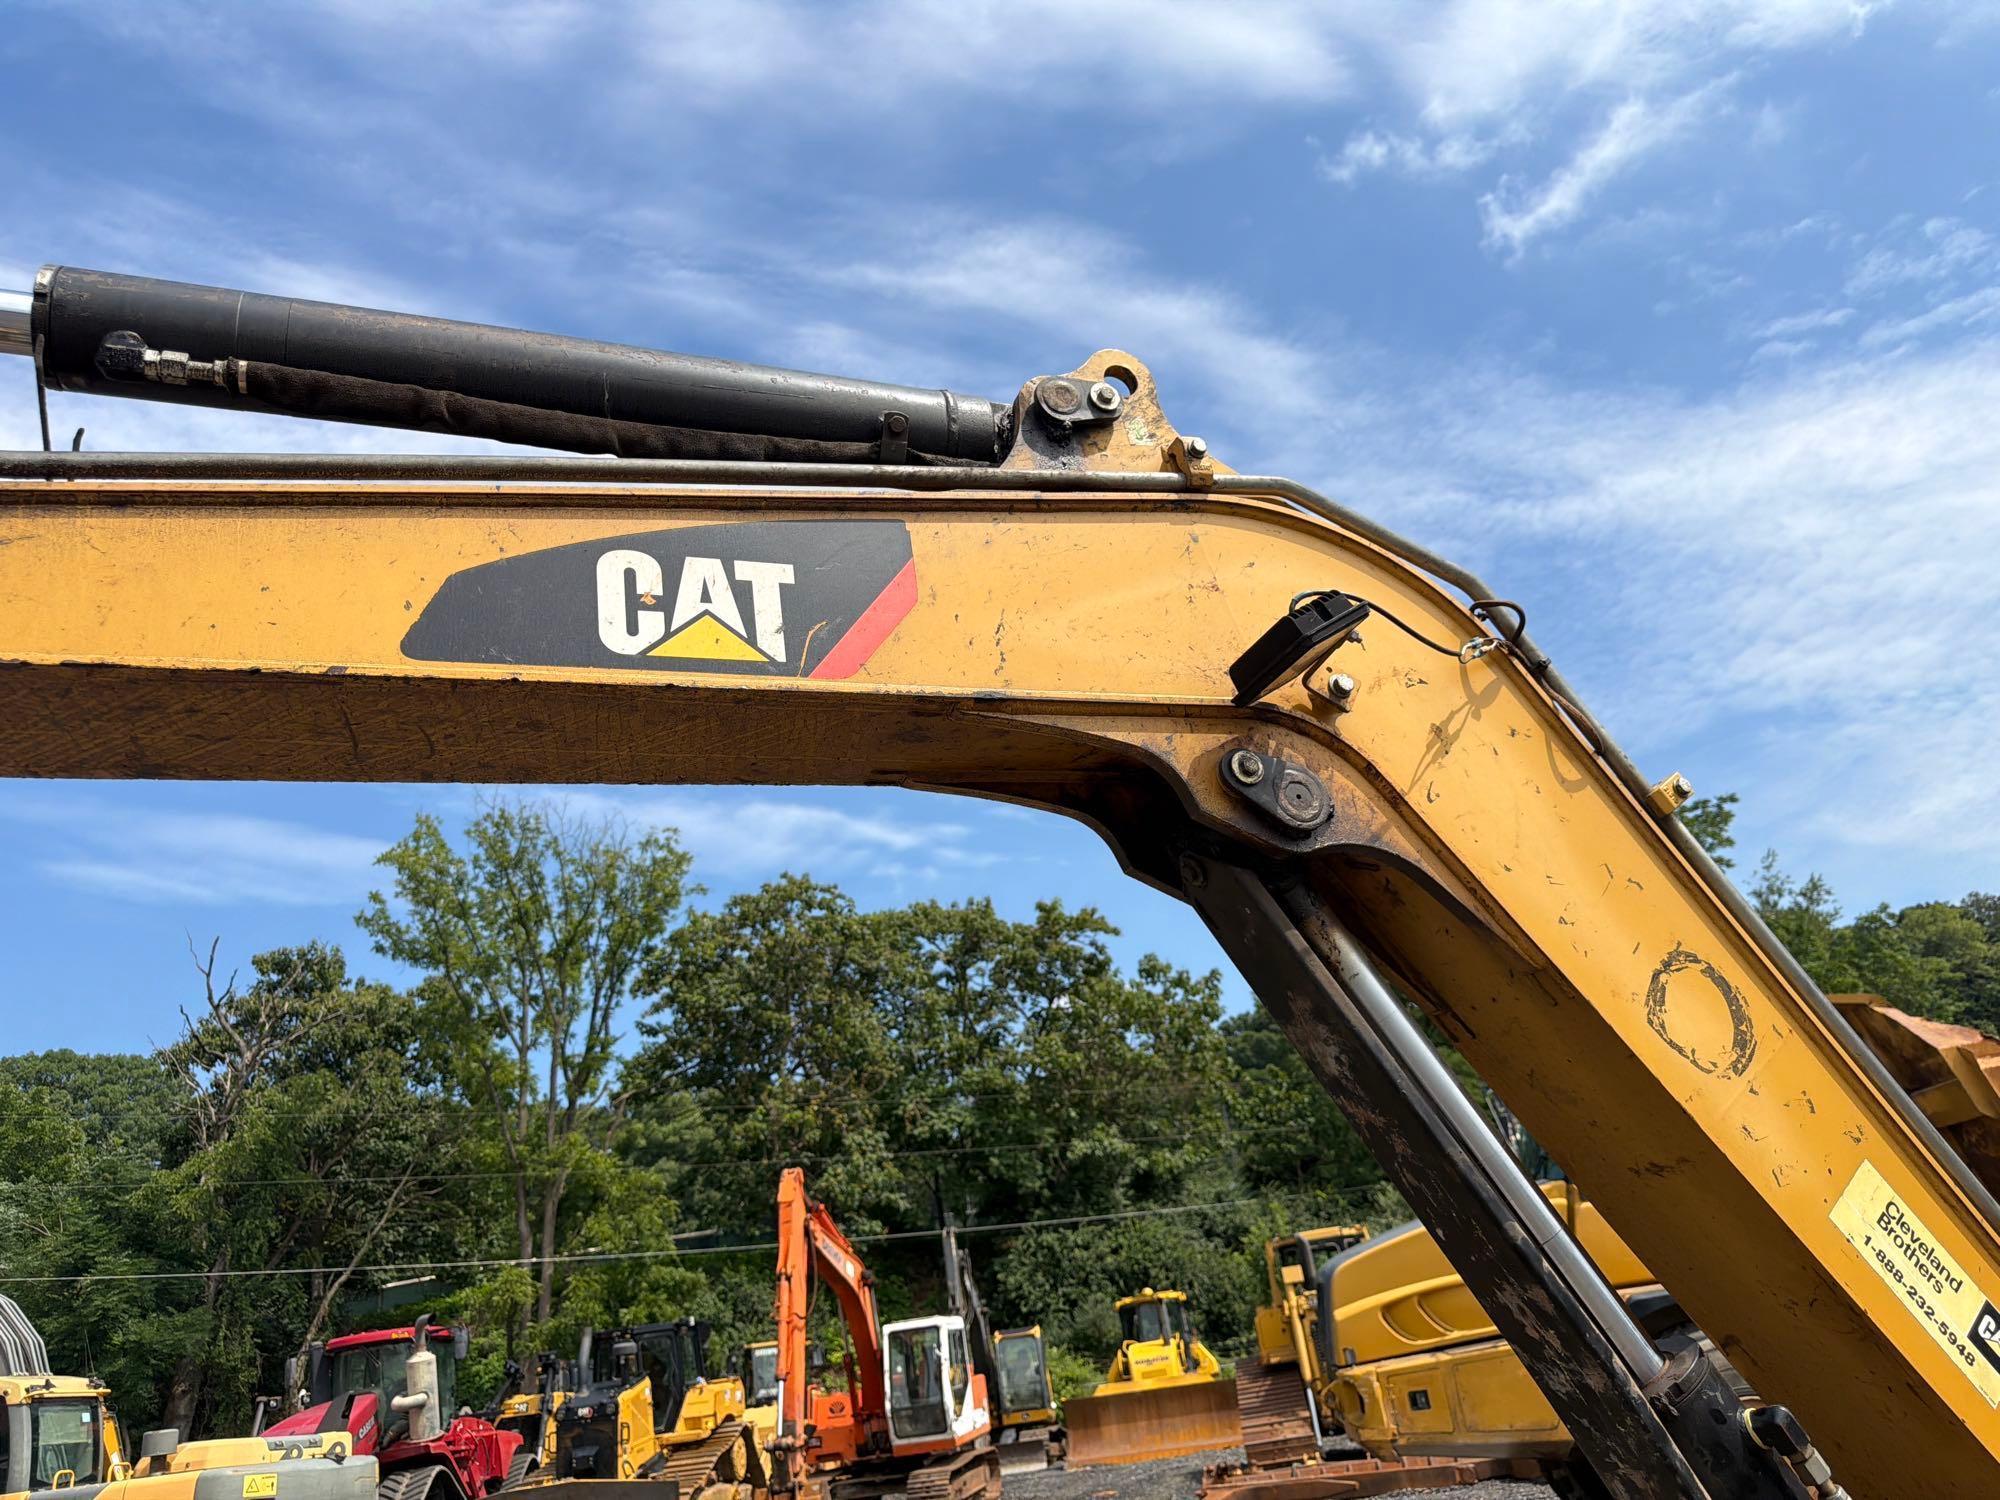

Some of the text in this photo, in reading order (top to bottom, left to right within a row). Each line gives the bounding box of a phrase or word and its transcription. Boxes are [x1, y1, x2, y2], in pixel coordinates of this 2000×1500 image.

[596, 549, 795, 663] CAT
[1876, 1211, 1944, 1294] Brothers
[1885, 1201, 1963, 1293] Cleveland
[1863, 1234, 1976, 1367] 1-888-232-5948
